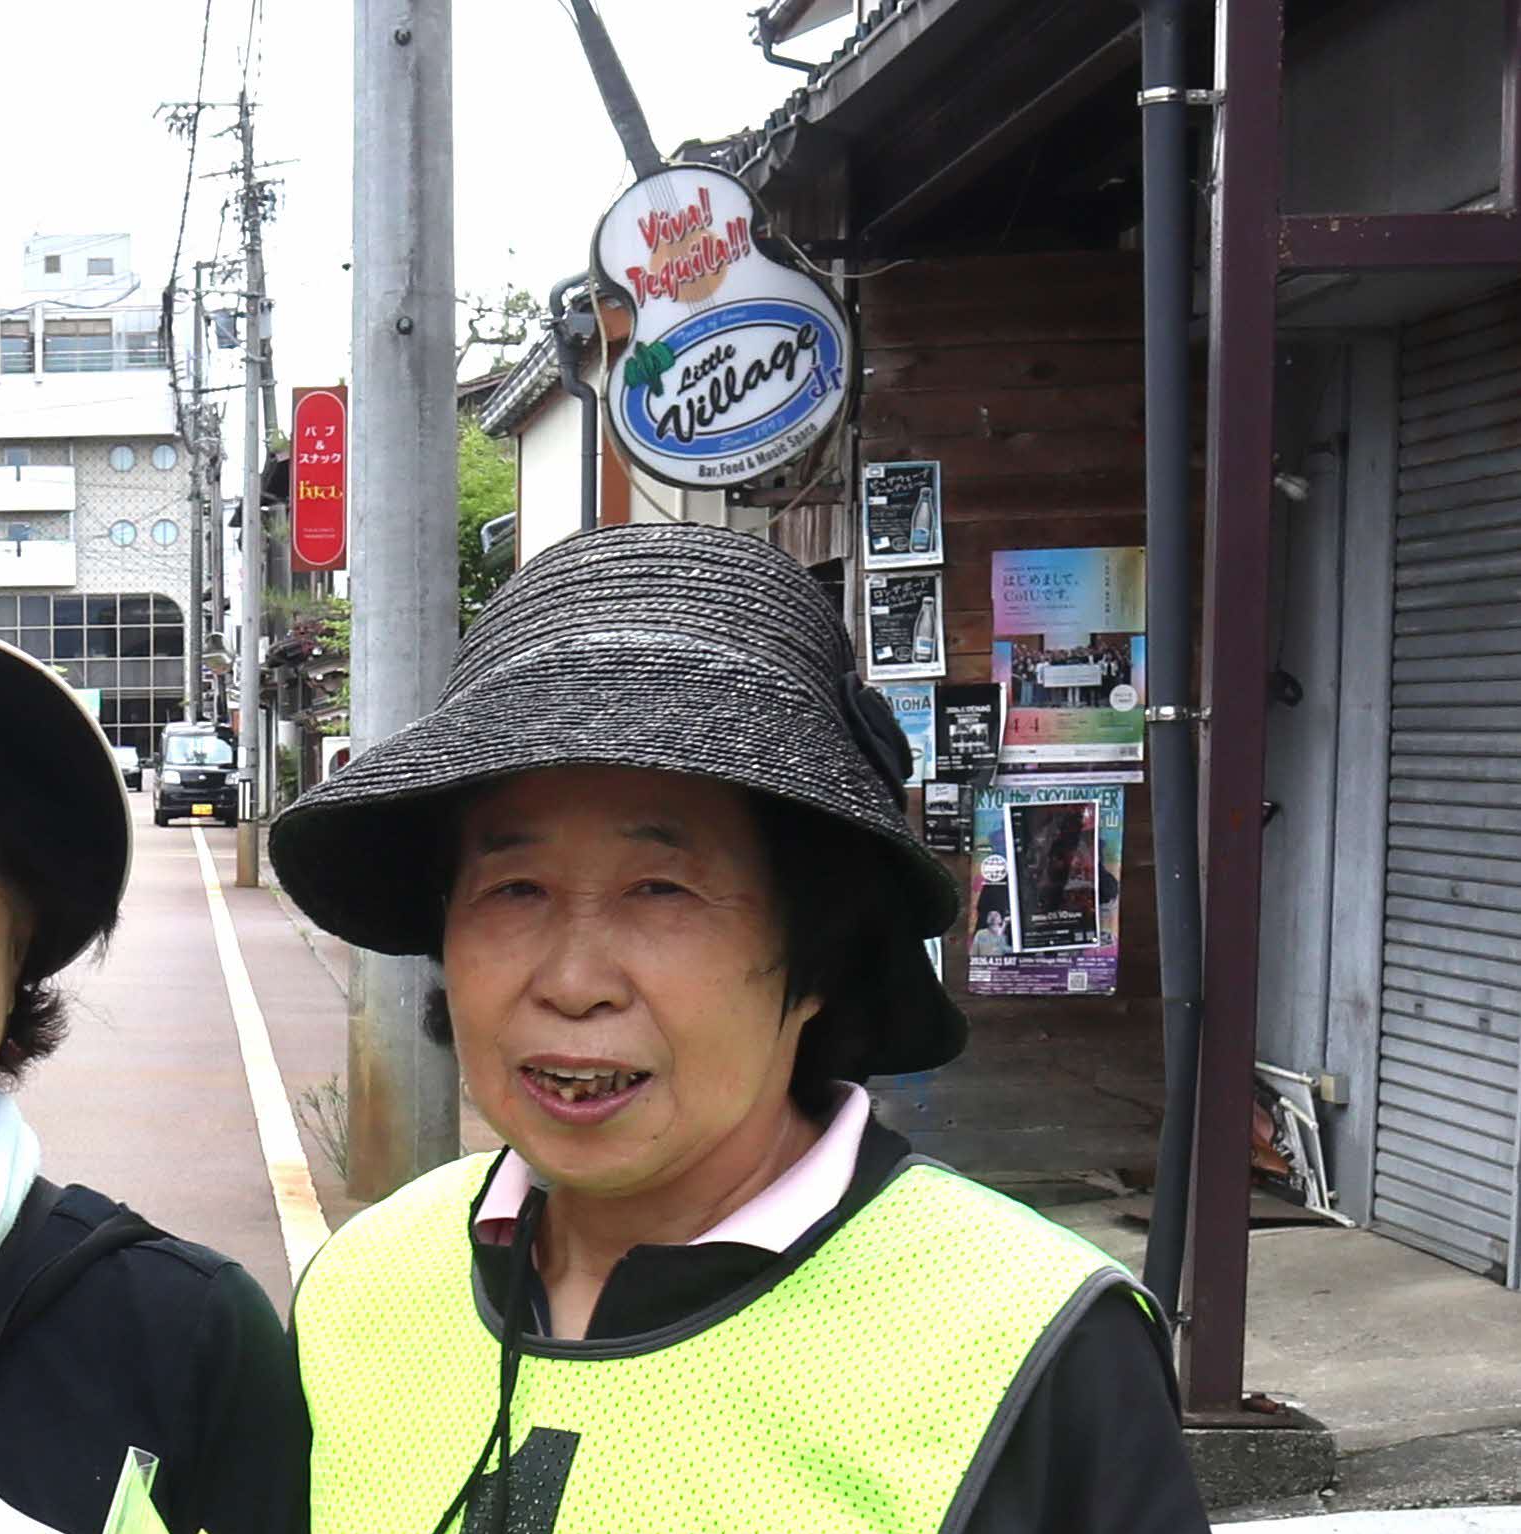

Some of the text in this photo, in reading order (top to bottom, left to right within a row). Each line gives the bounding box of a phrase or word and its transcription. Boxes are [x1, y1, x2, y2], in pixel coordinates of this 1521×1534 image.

[637, 187, 713, 251] Viva!
[625, 216, 751, 308] Tequila!!
[657, 323, 819, 443] Village
[677, 343, 737, 396] Little
[298, 453, 342, 464] スナック
